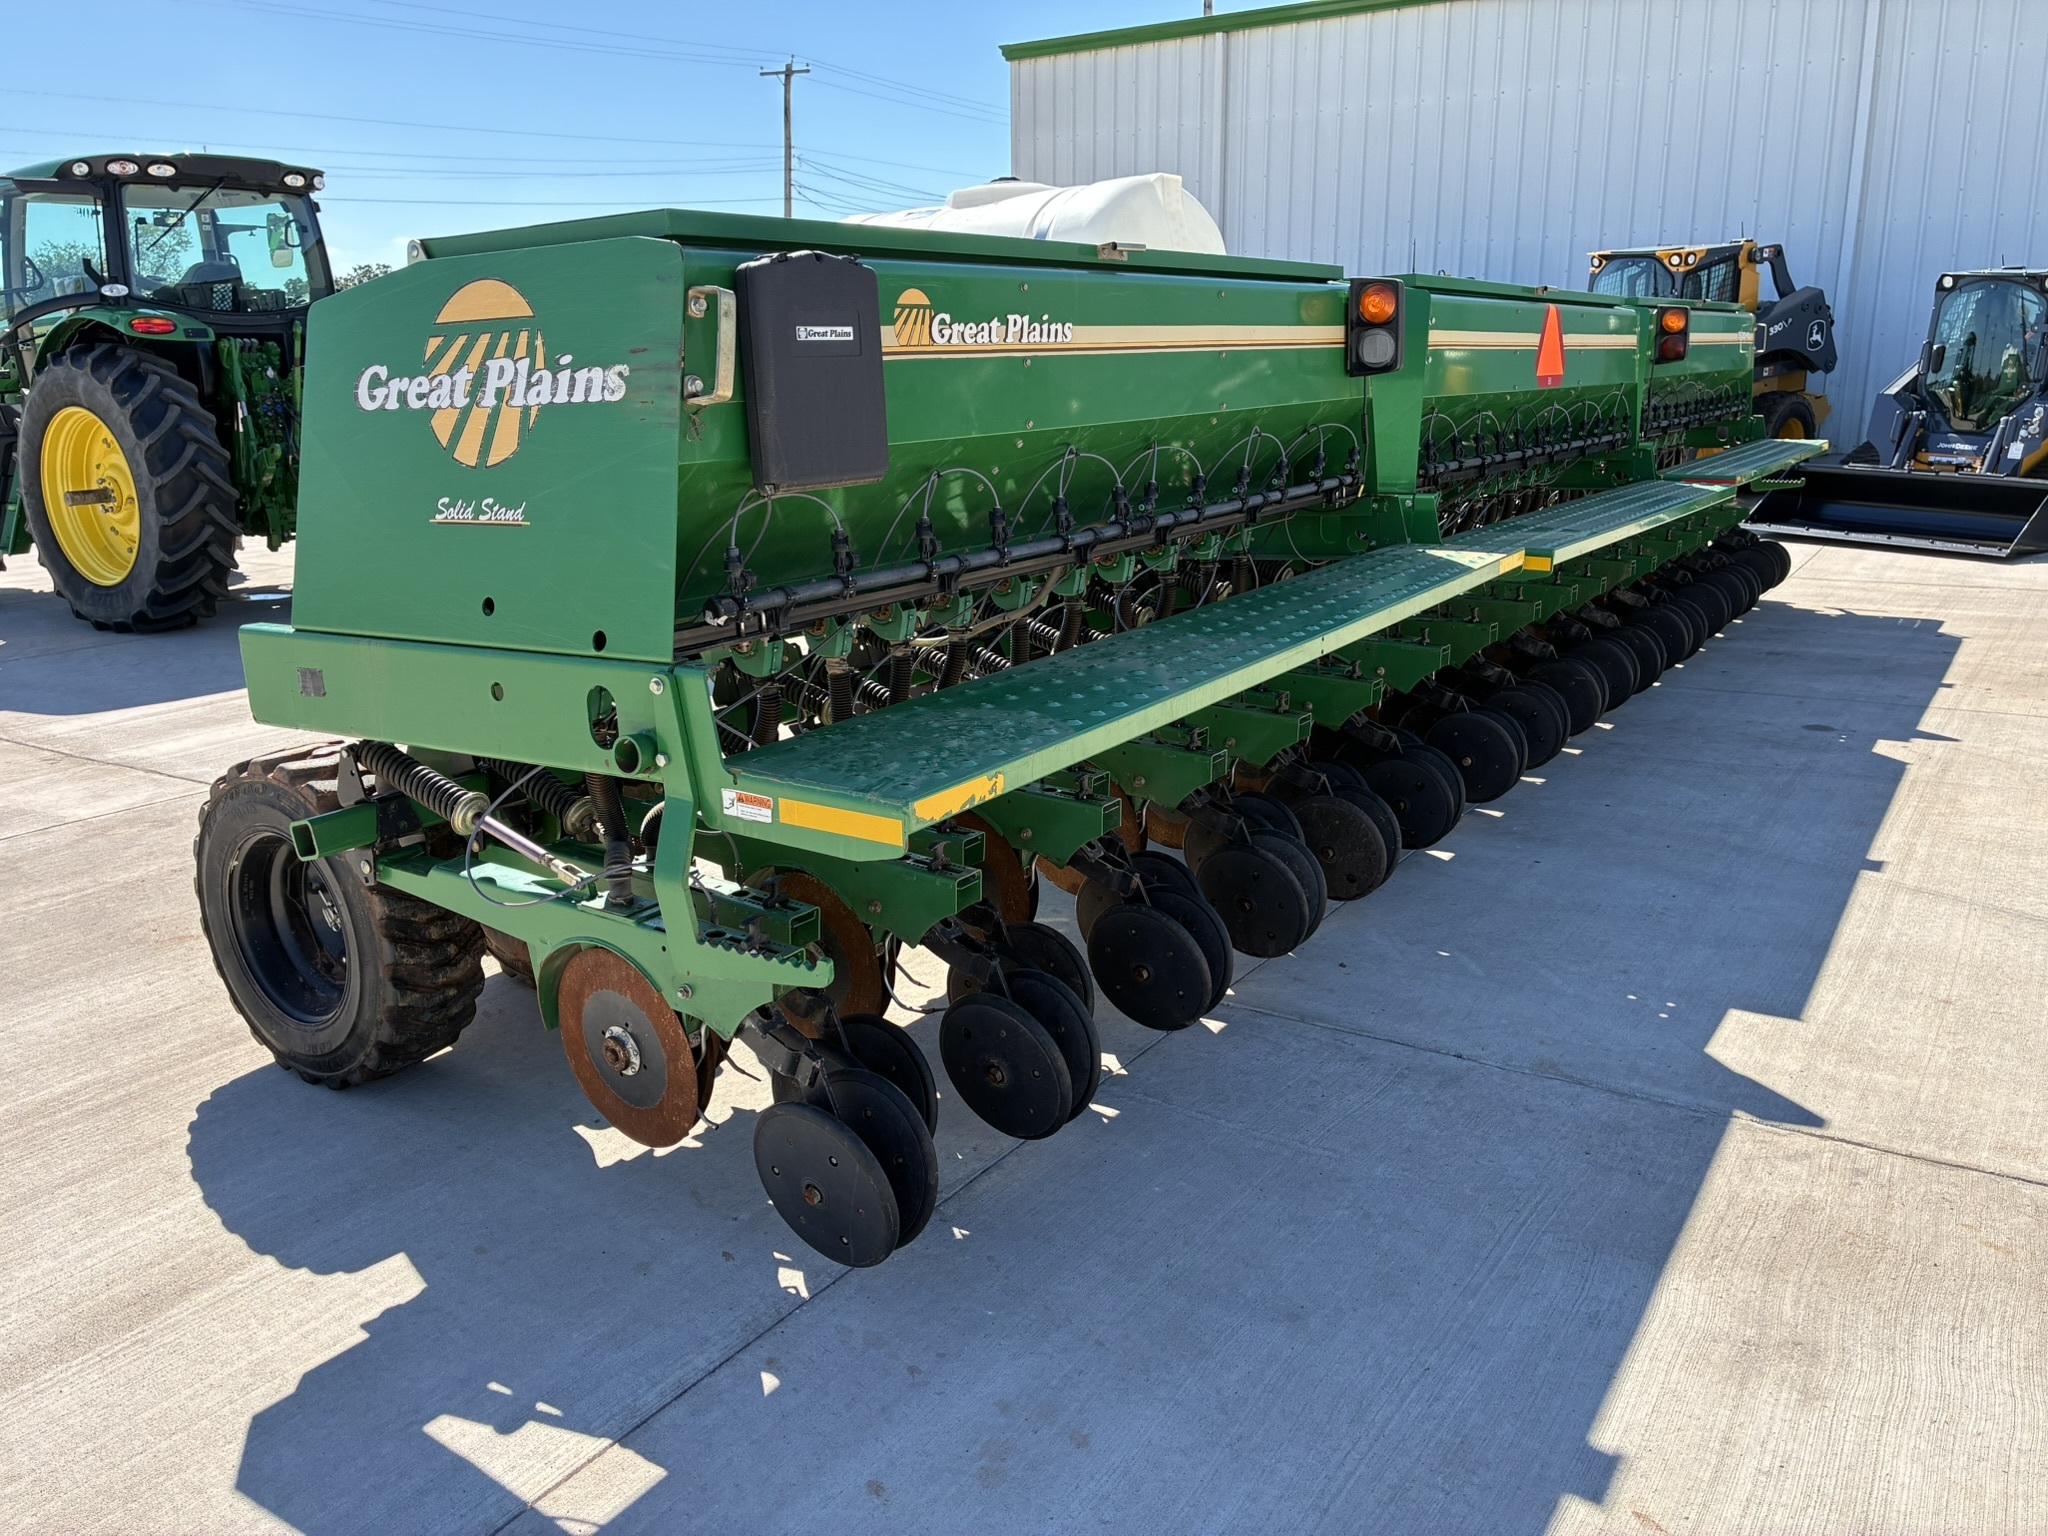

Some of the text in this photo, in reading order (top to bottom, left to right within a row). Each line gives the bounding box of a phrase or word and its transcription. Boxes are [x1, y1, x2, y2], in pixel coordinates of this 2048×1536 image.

[808, 328, 852, 338] Great Plains
[931, 313, 1073, 345] Great Plains
[355, 353, 631, 412] Great Plains
[1955, 442, 1979, 451] DEERE
[435, 496, 526, 522] Solid Stand
[744, 794, 772, 809] WARNING
